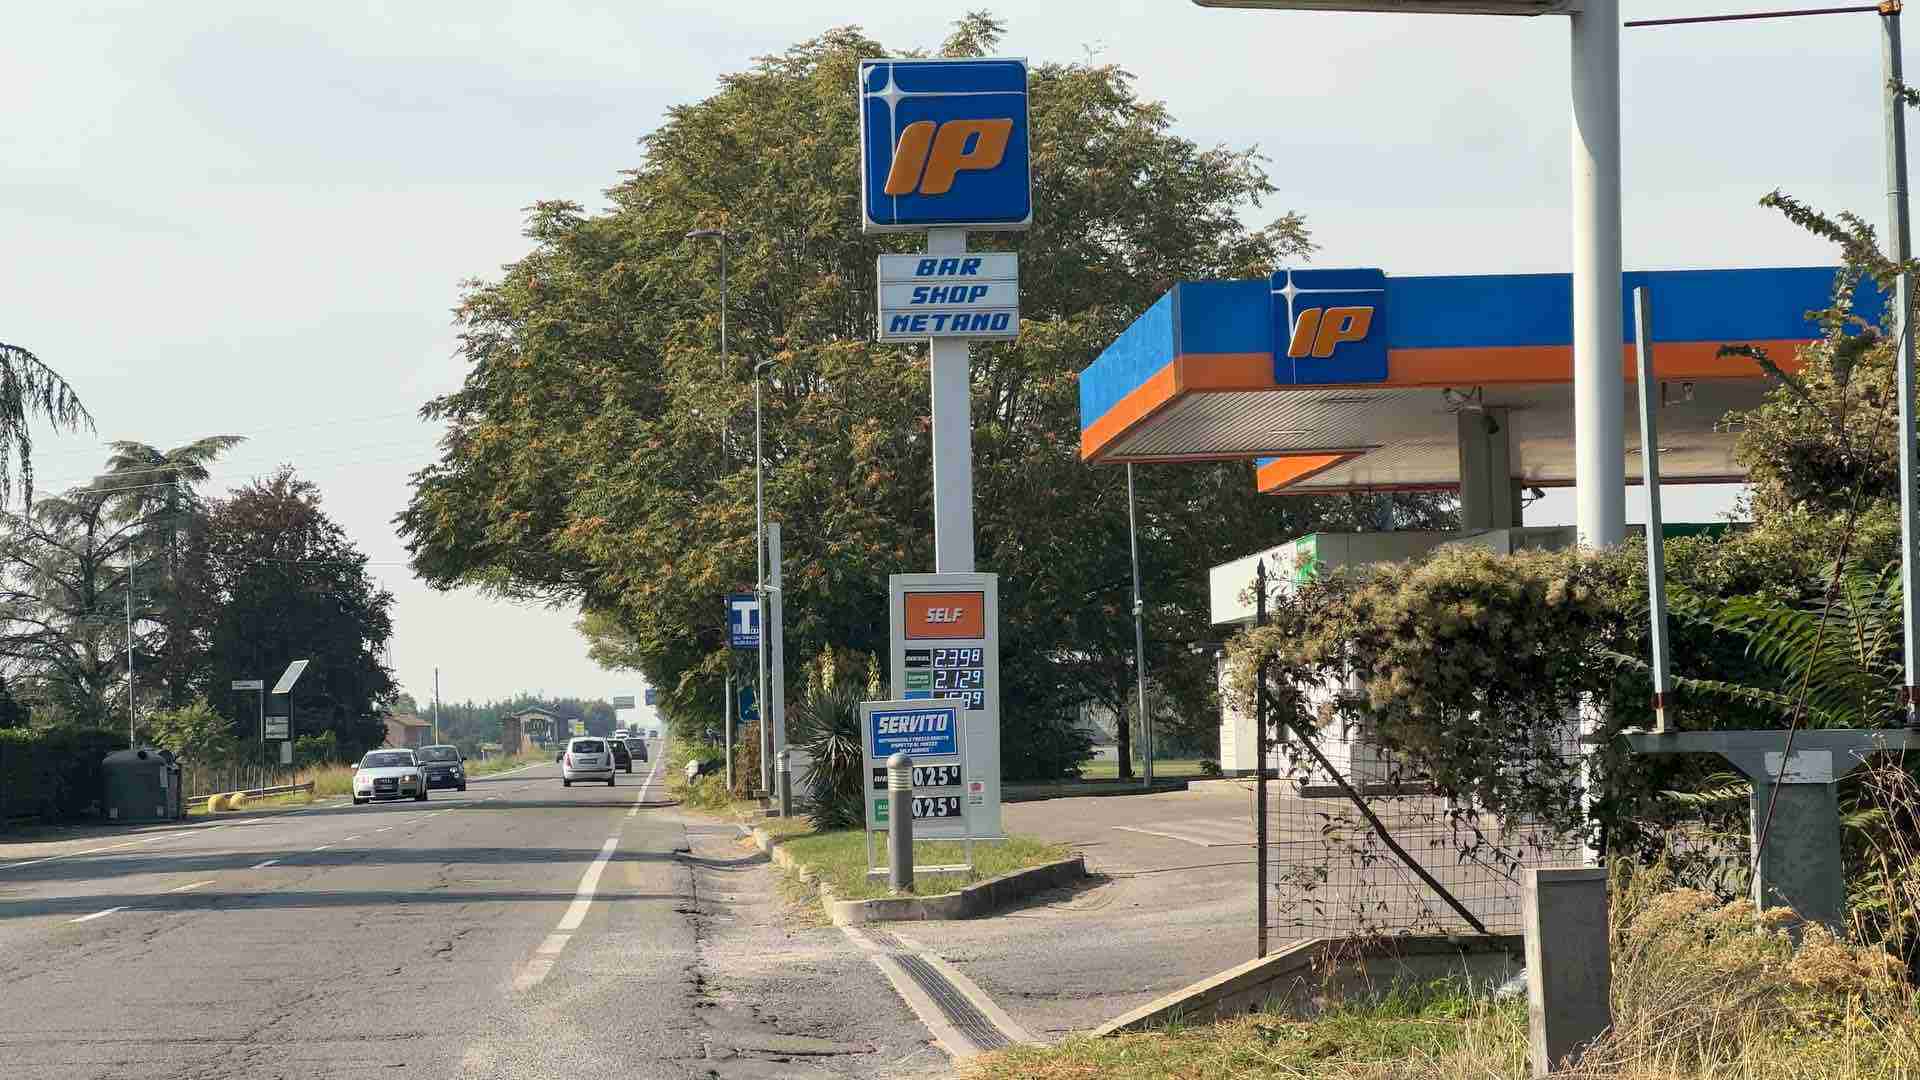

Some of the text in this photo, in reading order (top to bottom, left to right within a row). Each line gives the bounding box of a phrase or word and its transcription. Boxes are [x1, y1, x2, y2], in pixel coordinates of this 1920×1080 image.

[884, 118, 1013, 194] IP
[916, 258, 981, 276] BAR
[910, 285, 988, 304] SHOP
[889, 313, 1010, 332] METANO
[1288, 306, 1374, 357] IP
[926, 607, 963, 624] SELF
[878, 713, 949, 734] SERVITO
